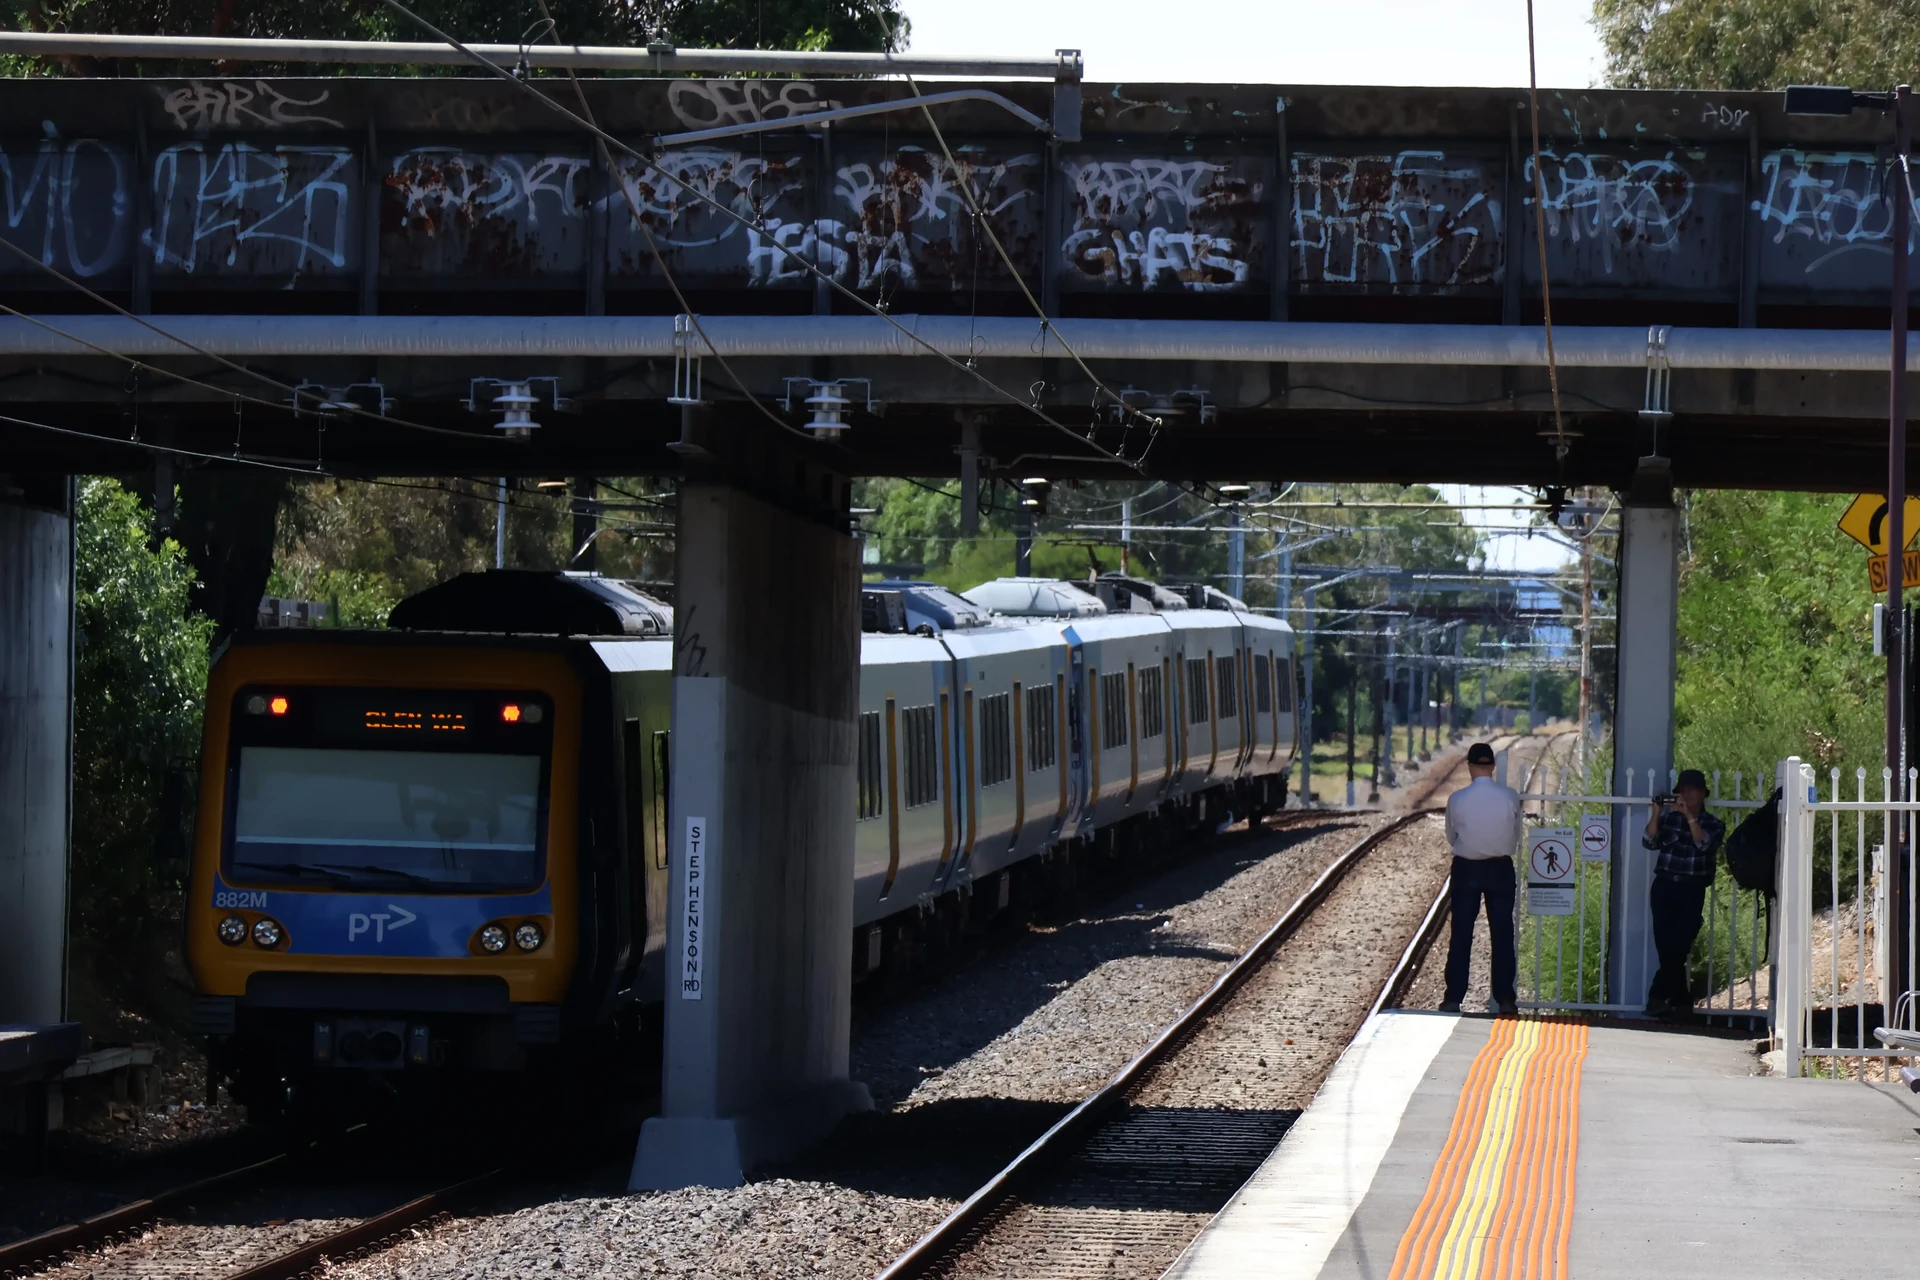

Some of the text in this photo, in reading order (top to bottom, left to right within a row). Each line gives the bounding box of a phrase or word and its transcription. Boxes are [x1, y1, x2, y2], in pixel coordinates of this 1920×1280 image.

[1872, 555, 1918, 588] SLW
[216, 892, 267, 908] 882M
[687, 826, 701, 972] STEPHENSON
[684, 980, 700, 992] RD
